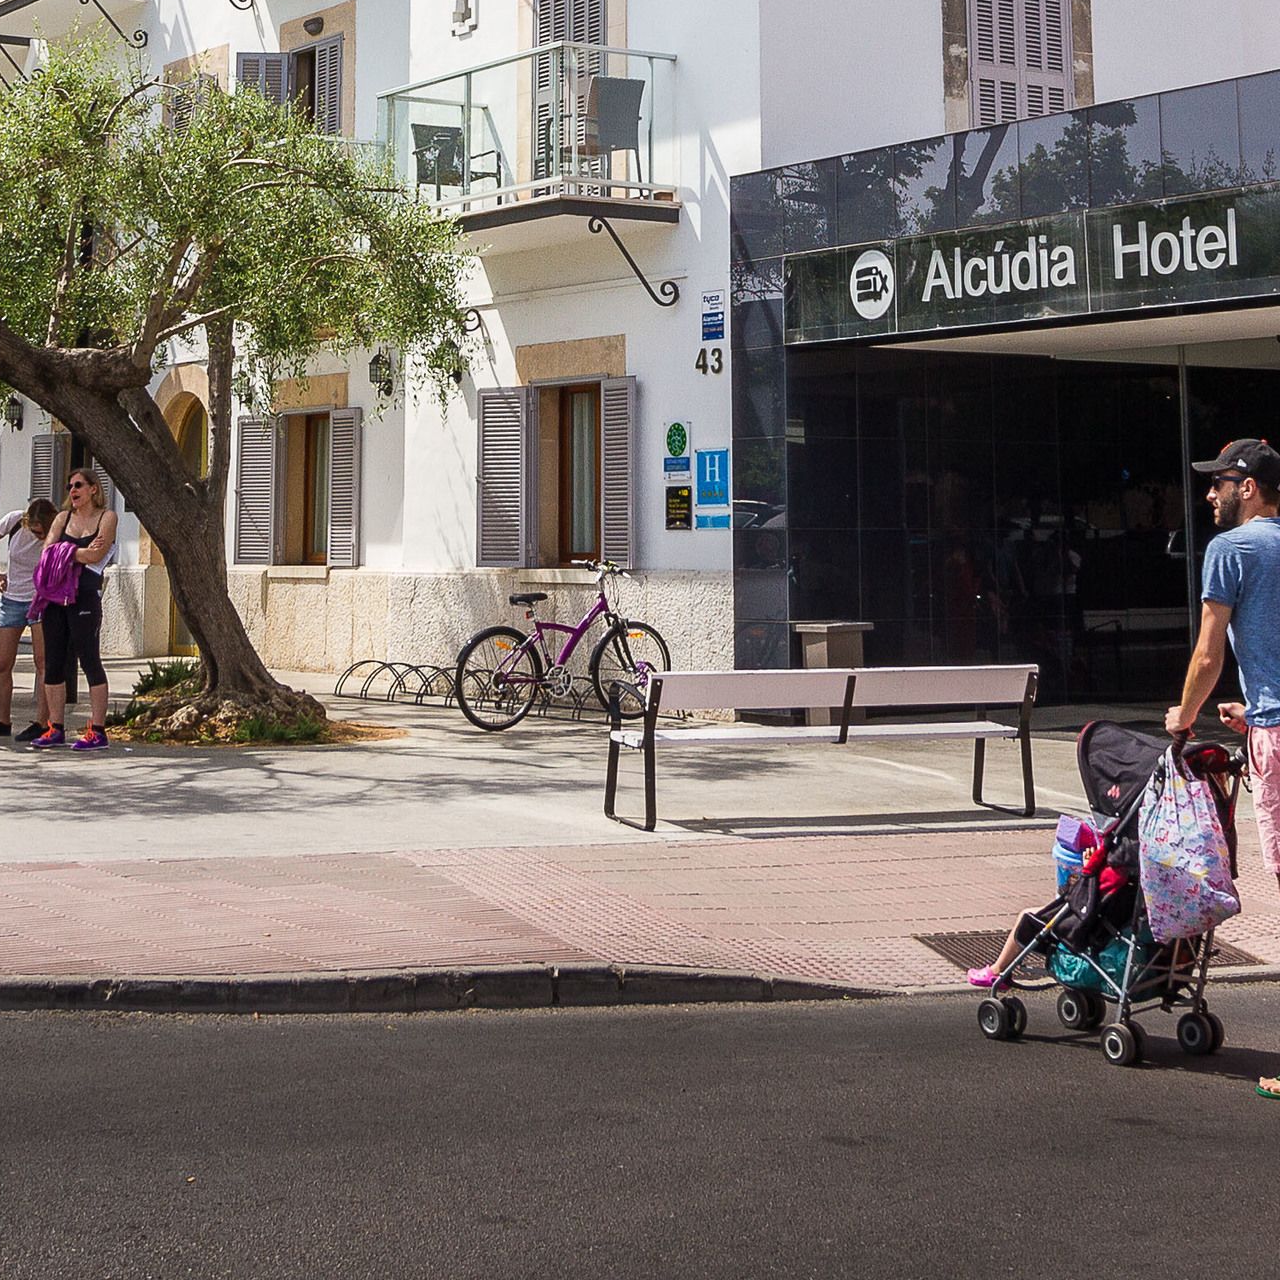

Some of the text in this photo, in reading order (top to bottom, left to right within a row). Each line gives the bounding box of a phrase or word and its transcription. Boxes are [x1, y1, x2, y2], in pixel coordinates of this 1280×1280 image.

[921, 234, 1077, 302] Alcúdia
[1113, 208, 1238, 279] Hotel
[695, 347, 723, 375] 43
[705, 454, 721, 482] H
